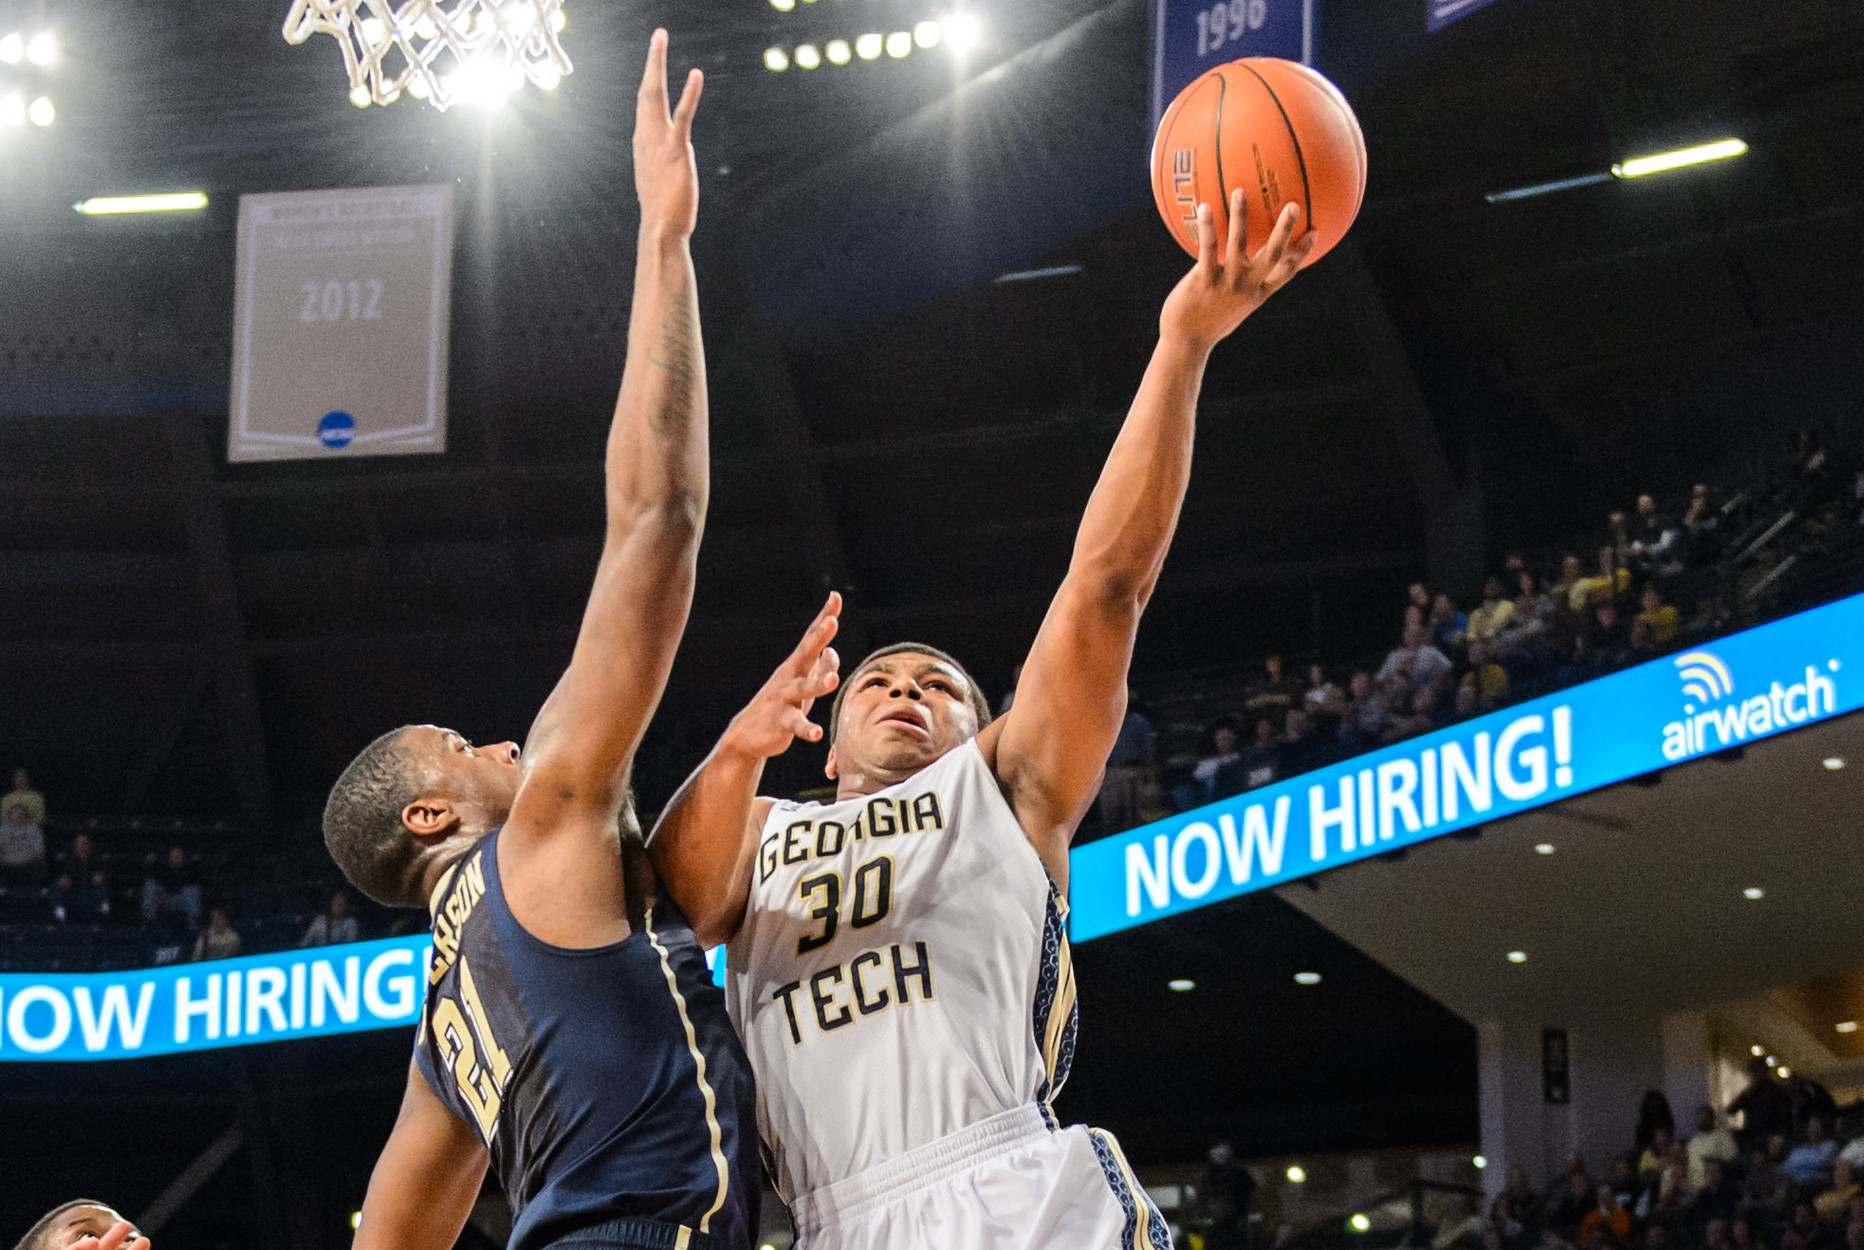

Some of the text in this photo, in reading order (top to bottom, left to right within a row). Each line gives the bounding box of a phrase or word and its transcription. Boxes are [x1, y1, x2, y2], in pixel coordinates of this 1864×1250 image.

[300, 279, 382, 322] 2012
[1662, 665, 1836, 761] airwatch
[1125, 705, 1573, 917] NOW HIRING!
[797, 853, 895, 957] 30
[0, 981, 156, 1053] OW
[772, 941, 936, 1047] TECH
[431, 953, 514, 1150] 21
